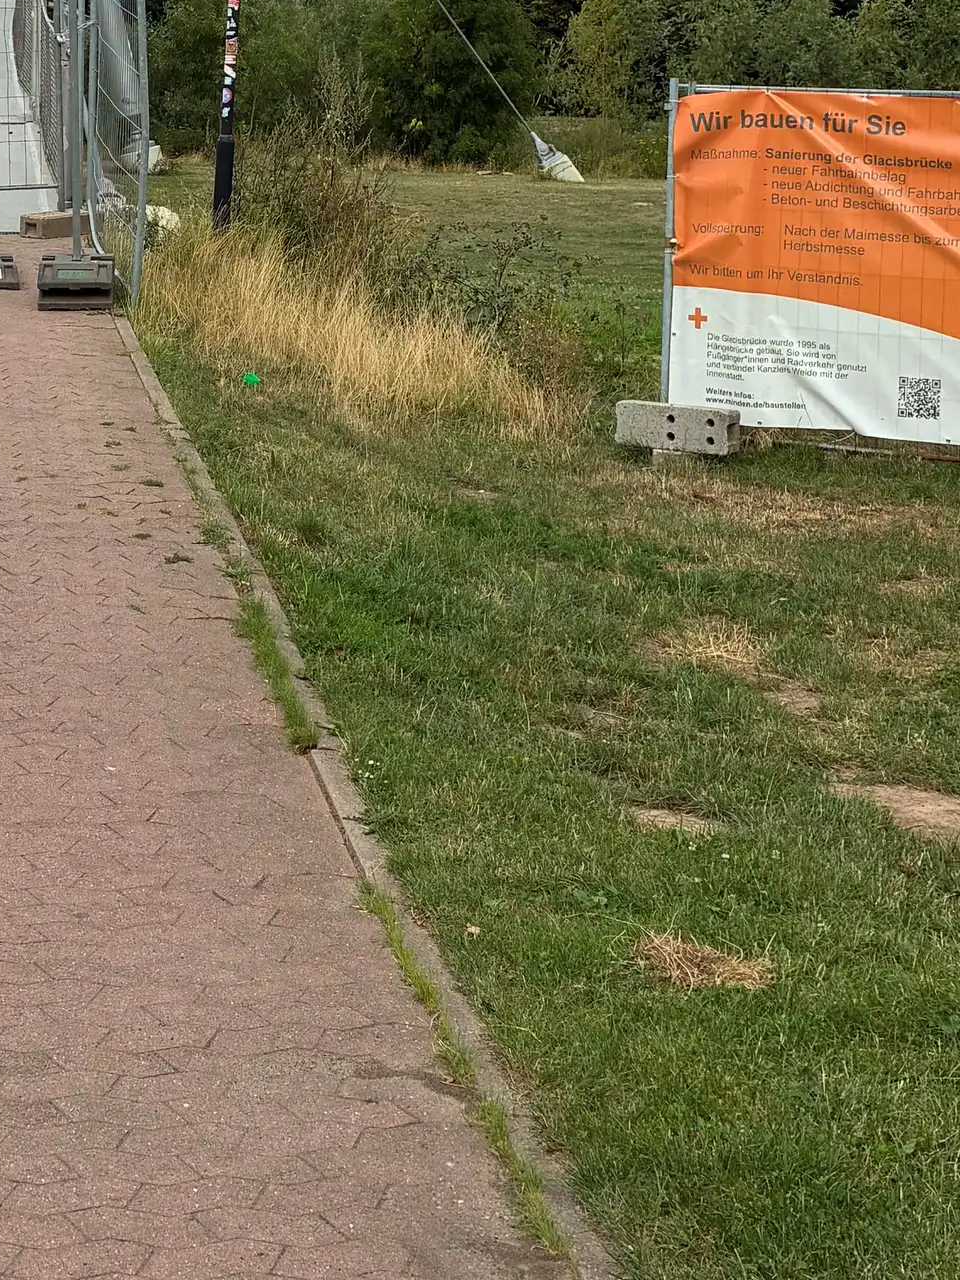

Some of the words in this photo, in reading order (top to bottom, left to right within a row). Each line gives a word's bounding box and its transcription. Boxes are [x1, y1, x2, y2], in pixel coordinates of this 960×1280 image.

[690, 111, 732, 133] Wir
[740, 109, 814, 130] bauen
[823, 112, 858, 133] für
[866, 114, 906, 136] Sie
[690, 148, 761, 160] Maßnahme:
[765, 148, 831, 165] Sanierung
[836, 152, 858, 164] der
[863, 154, 952, 169] Glacisbrücke
[772, 165, 808, 176] neuer
[812, 165, 906, 184] Fahrbahnbelag
[771, 180, 802, 190] neue
[805, 180, 874, 197] Abdichtung
[879, 187, 902, 198] und
[771, 193, 812, 206] Beton-
[815, 198, 838, 208] und
[692, 222, 764, 236] Vollsperrung:
[784, 224, 816, 237] Nach
[820, 227, 840, 238] der
[844, 228, 910, 243] Maimesse
[914, 233, 931, 245] bis
[783, 239, 865, 255] Herbstmesse
[689, 263, 710, 275] Wir
[713, 265, 742, 278] bitten
[747, 271, 763, 279] um
[768, 268, 784, 280] Ihr
[787, 270, 863, 287] Verständnis.
[707, 333, 720, 341] Die
[721, 334, 767, 345] Glacisbrücke
[769, 339, 794, 347] wurde
[797, 340, 817, 349] 1995
[819, 343, 831, 351] als
[786, 348, 800, 357] Sie
[802, 351, 819, 359] wird
[706, 361, 721, 369] und
[722, 363, 755, 373] verbindet
[757, 365, 791, 374] Kanzlers
[792, 367, 817, 377] Weide
[771, 357, 785, 365] und
[787, 358, 835, 369] Radverkehr
[837, 364, 867, 372] genutzt
[705, 387, 733, 397] Weitere
[734, 391, 755, 400] Infos:
[705, 397, 806, 410] www.minden.de/baustellen
